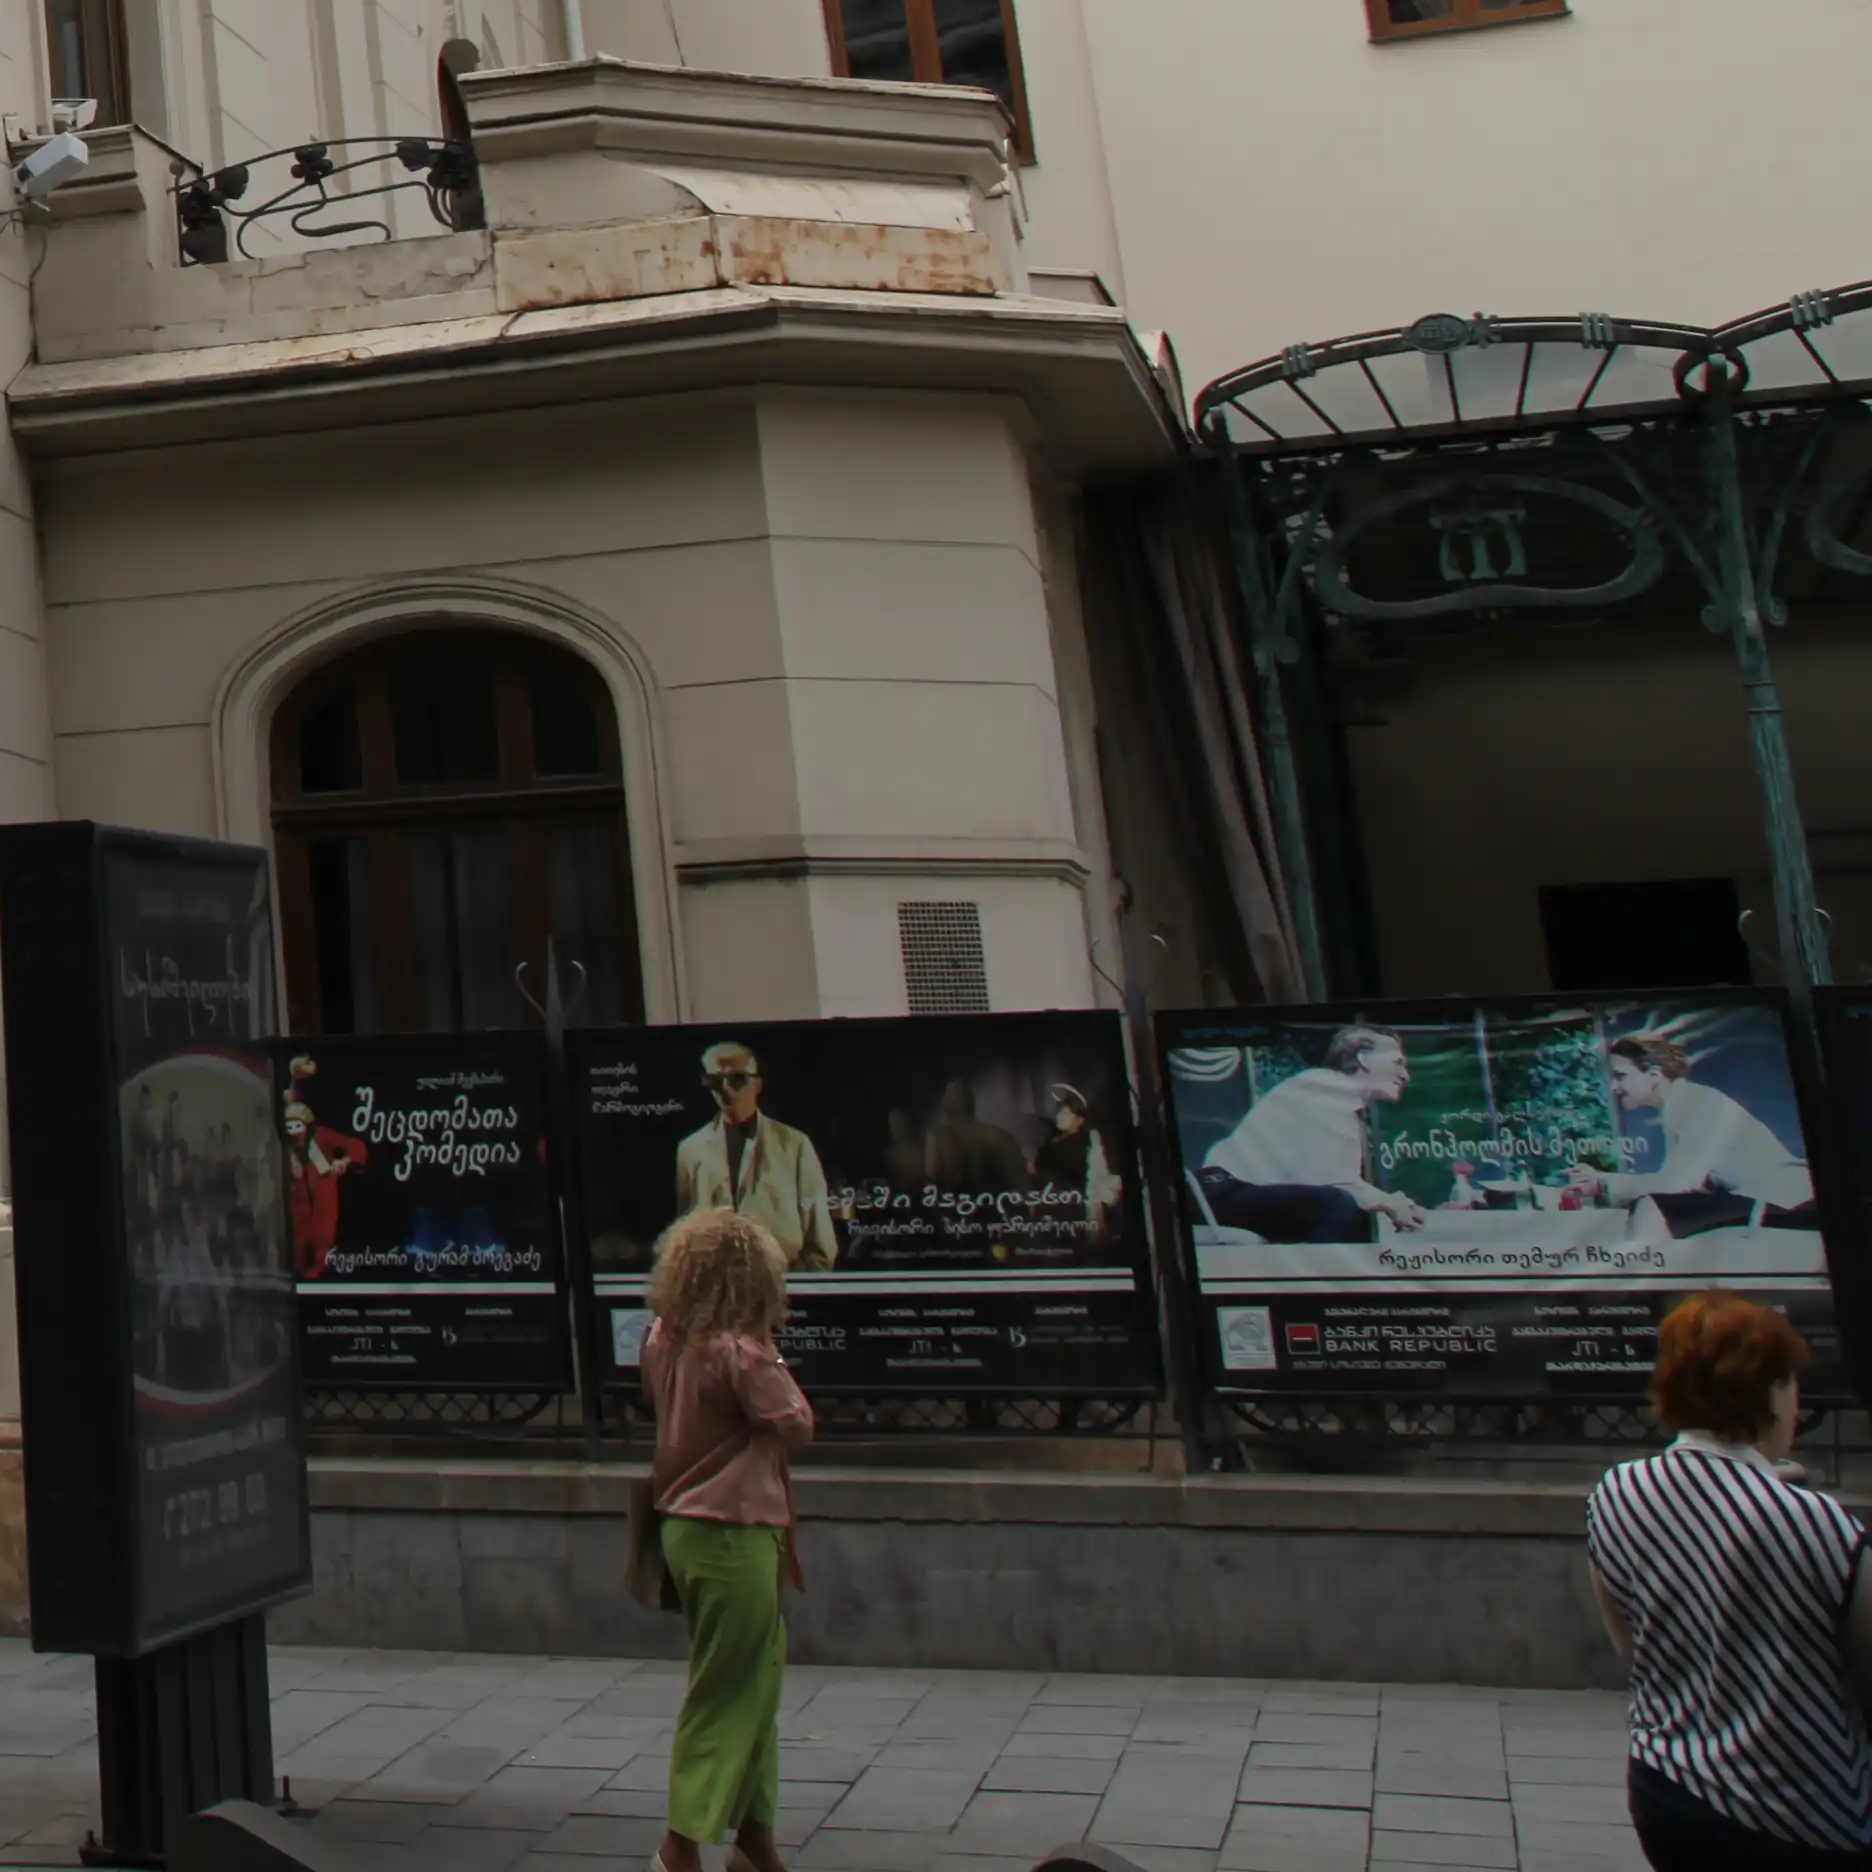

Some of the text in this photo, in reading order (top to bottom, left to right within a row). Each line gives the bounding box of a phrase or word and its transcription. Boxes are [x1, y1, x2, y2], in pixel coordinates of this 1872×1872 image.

[352, 1085, 519, 1144] შეცდომათა
[393, 1129, 522, 1182] კომედია
[922, 1181, 1102, 1216] მაგიდასთ
[1378, 1246, 1666, 1270] რეჟისორი თემურ ჩხეიძე
[779, 1338, 847, 1351] PUBLIC
[1325, 1338, 1498, 1353] BANK REPUBLIC
[1571, 1340, 1601, 1356] JTI
